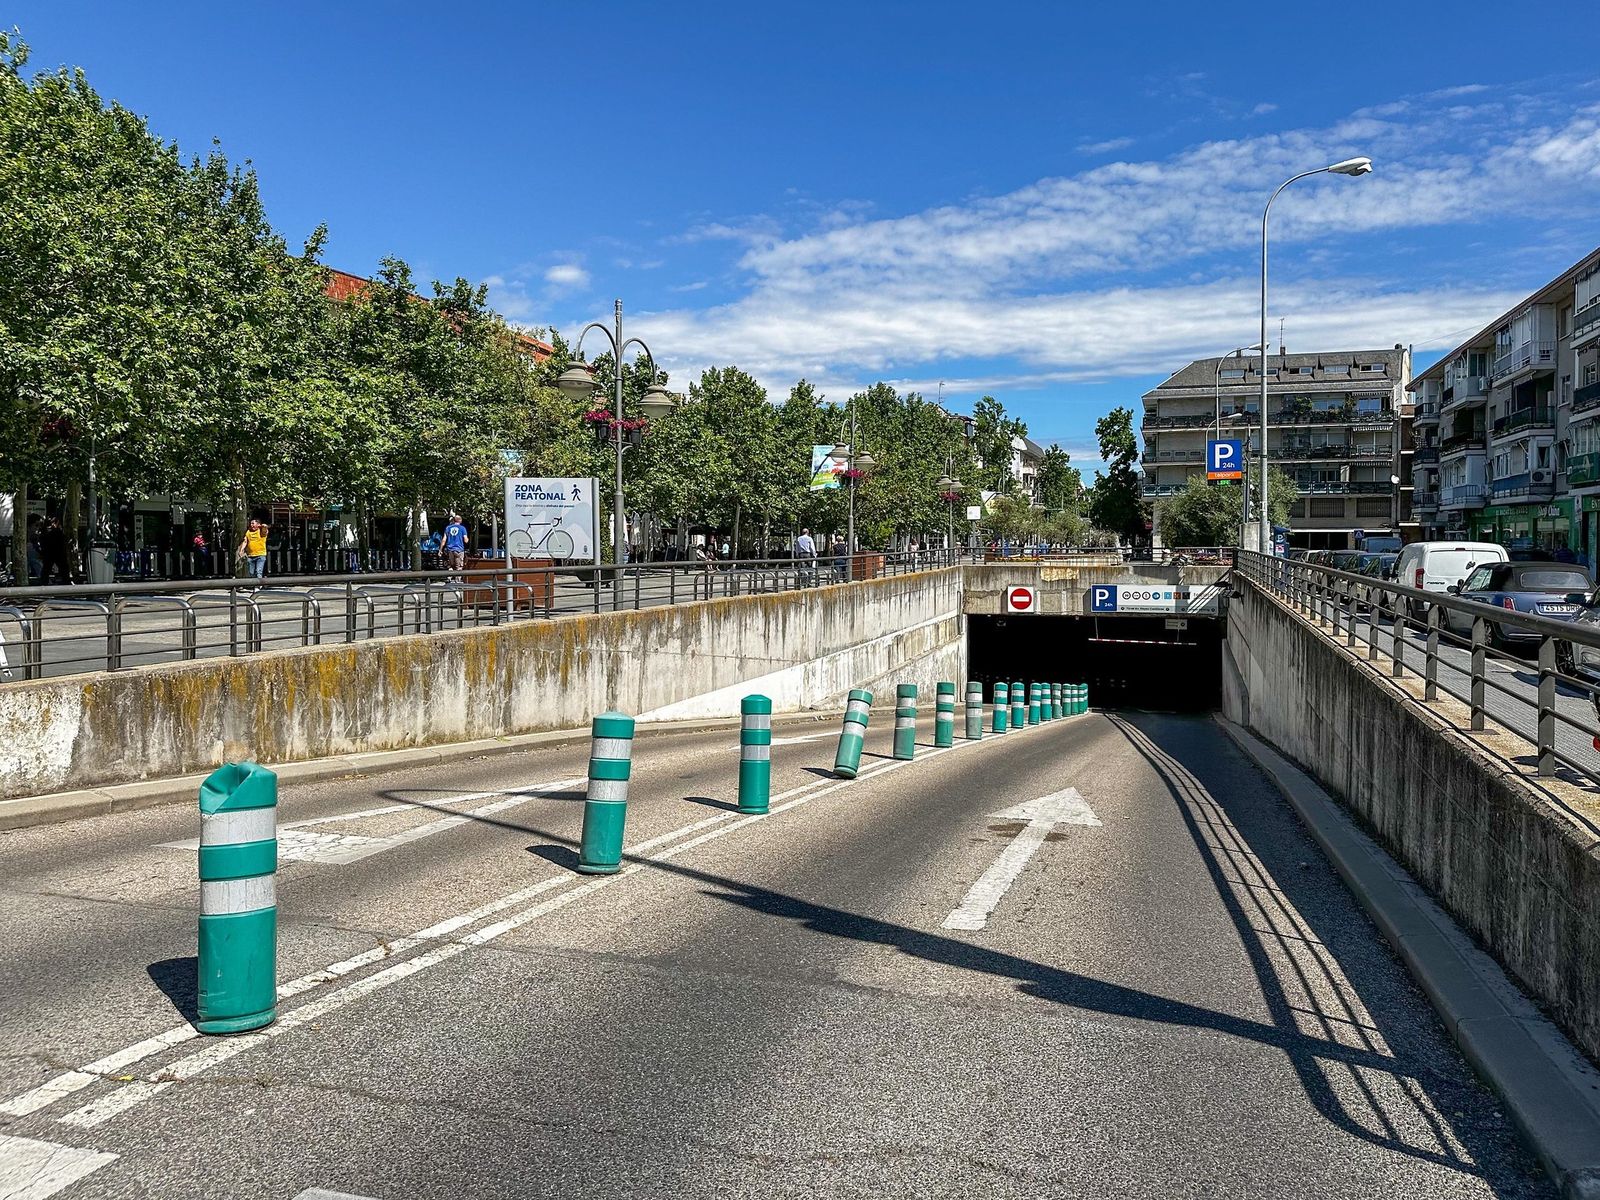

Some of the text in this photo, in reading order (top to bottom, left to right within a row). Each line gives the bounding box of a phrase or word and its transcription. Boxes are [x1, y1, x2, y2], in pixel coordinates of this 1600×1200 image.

[1215, 443, 1234, 469] P
[514, 484, 543, 493] ZONA
[515, 492, 566, 501] PEATONAL
[1095, 589, 1110, 607] P
